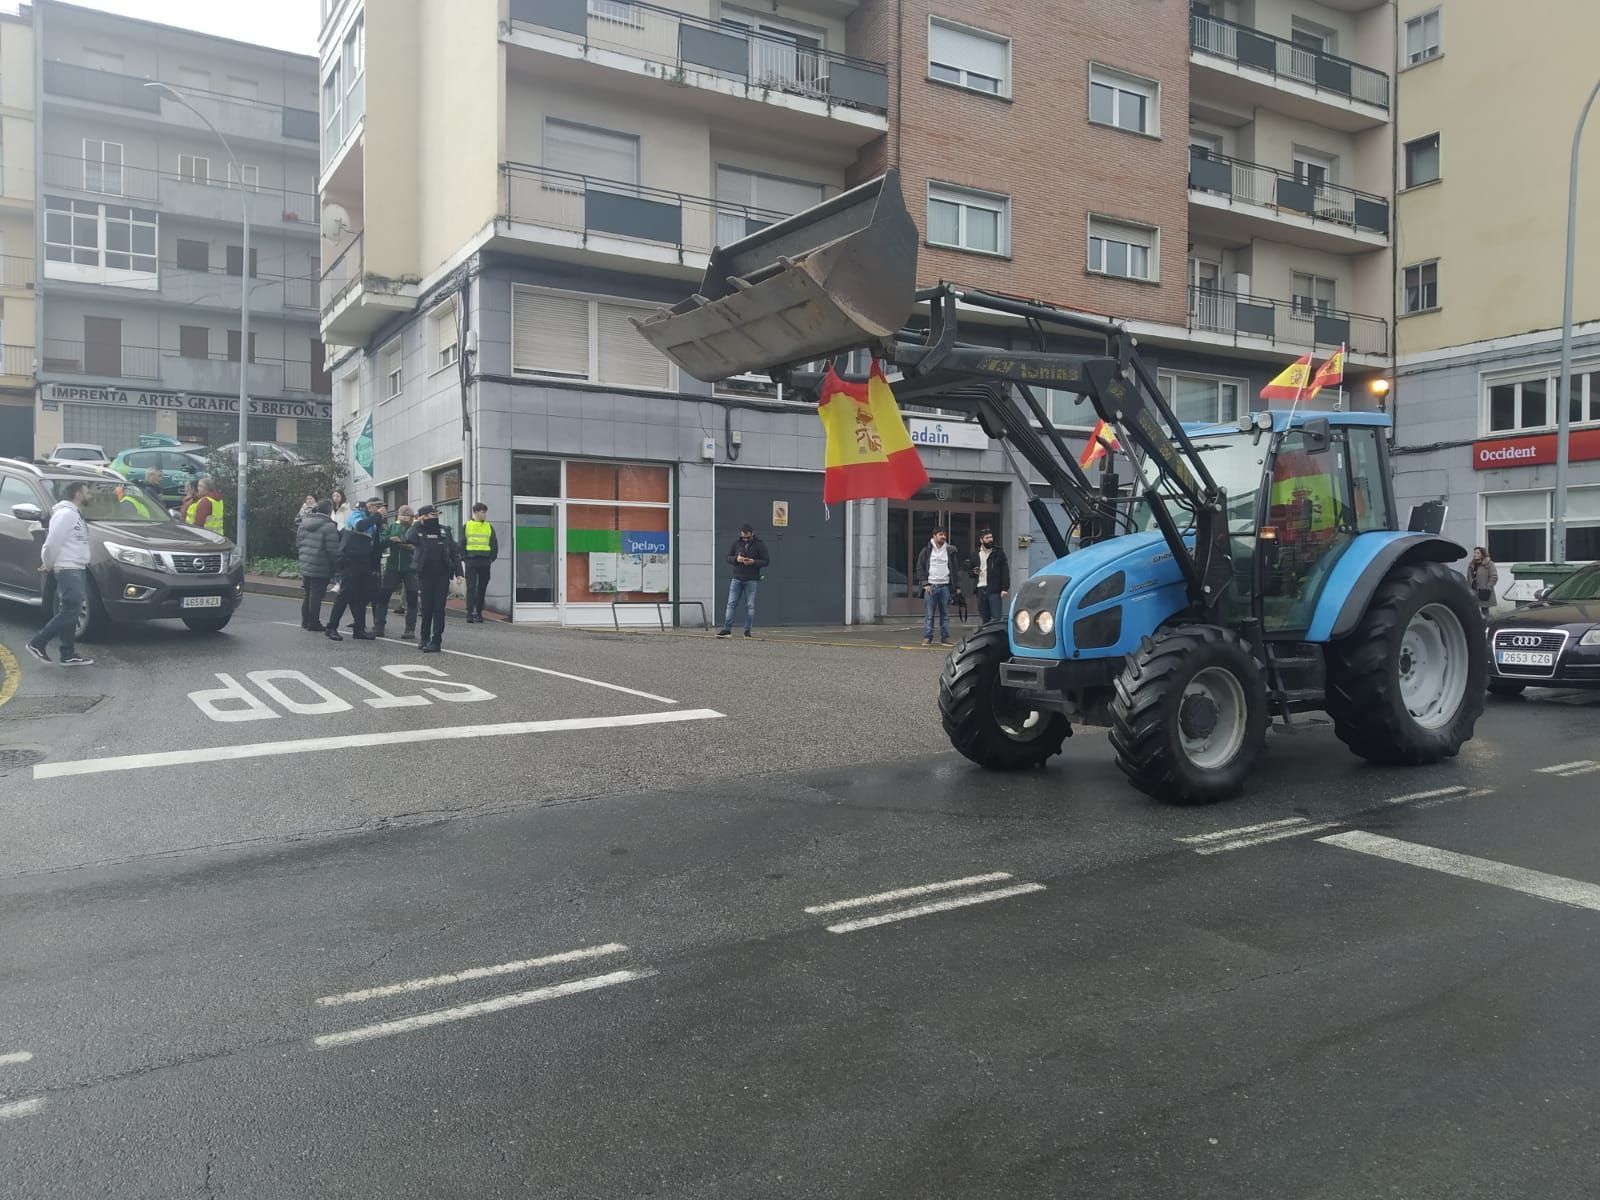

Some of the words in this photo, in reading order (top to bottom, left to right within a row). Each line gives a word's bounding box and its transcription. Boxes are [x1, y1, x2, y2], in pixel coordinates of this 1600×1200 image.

[52, 387, 128, 402] IMPRENTA
[138, 393, 183, 407] ARTES
[187, 397, 257, 413] GRAFICS
[911, 425, 949, 444] adain
[1480, 445, 1536, 461] Occident
[631, 541, 666, 552] pelayo
[1505, 653, 1528, 663] 2653
[1532, 654, 1550, 664] CZG
[188, 664, 497, 722] STOP
